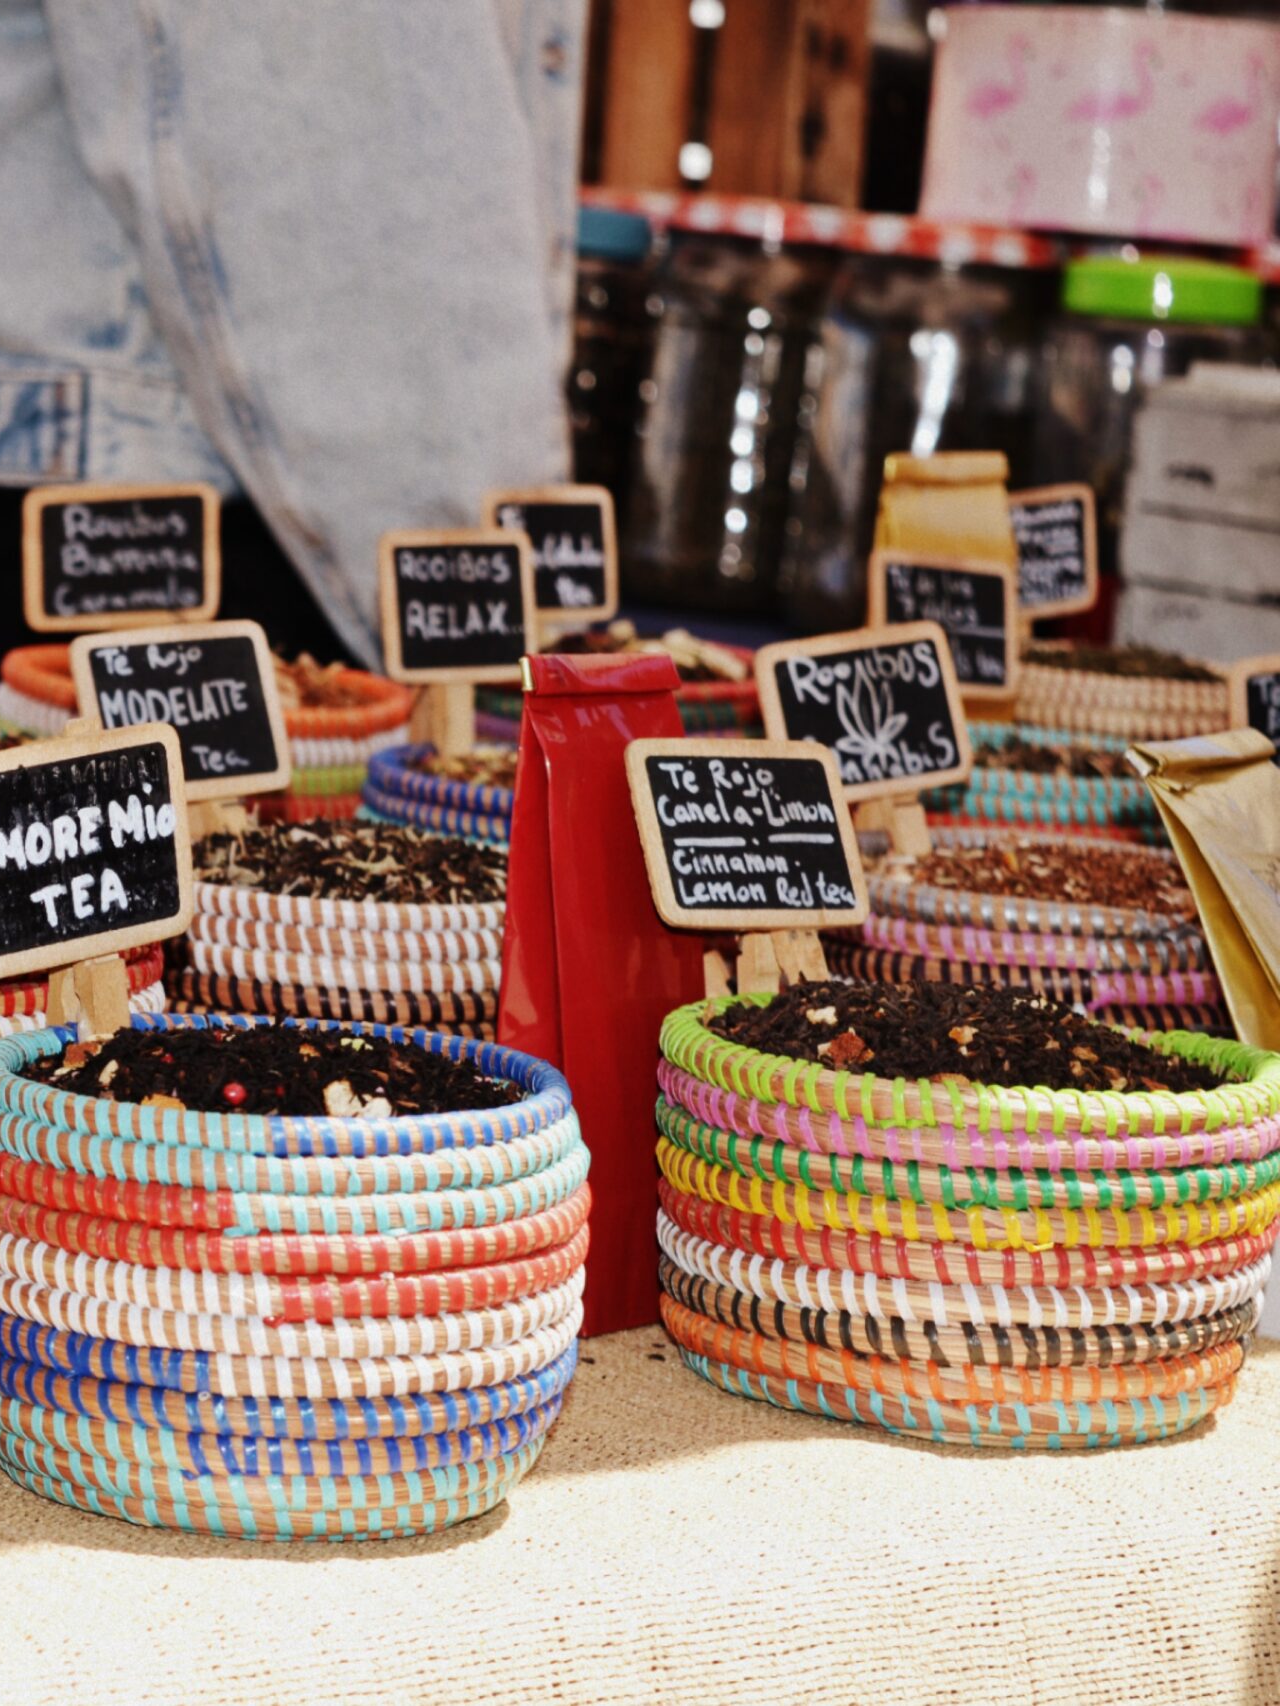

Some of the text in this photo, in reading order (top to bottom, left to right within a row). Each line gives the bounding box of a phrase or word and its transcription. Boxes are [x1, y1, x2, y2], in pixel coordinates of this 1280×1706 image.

[100, 679, 249, 729] MODELATE
[192, 745, 249, 772] Tea
[708, 759, 774, 798] Rojo
[30, 868, 128, 927] TEA
[678, 879, 767, 905] Lemon
[776, 872, 814, 907] Red
